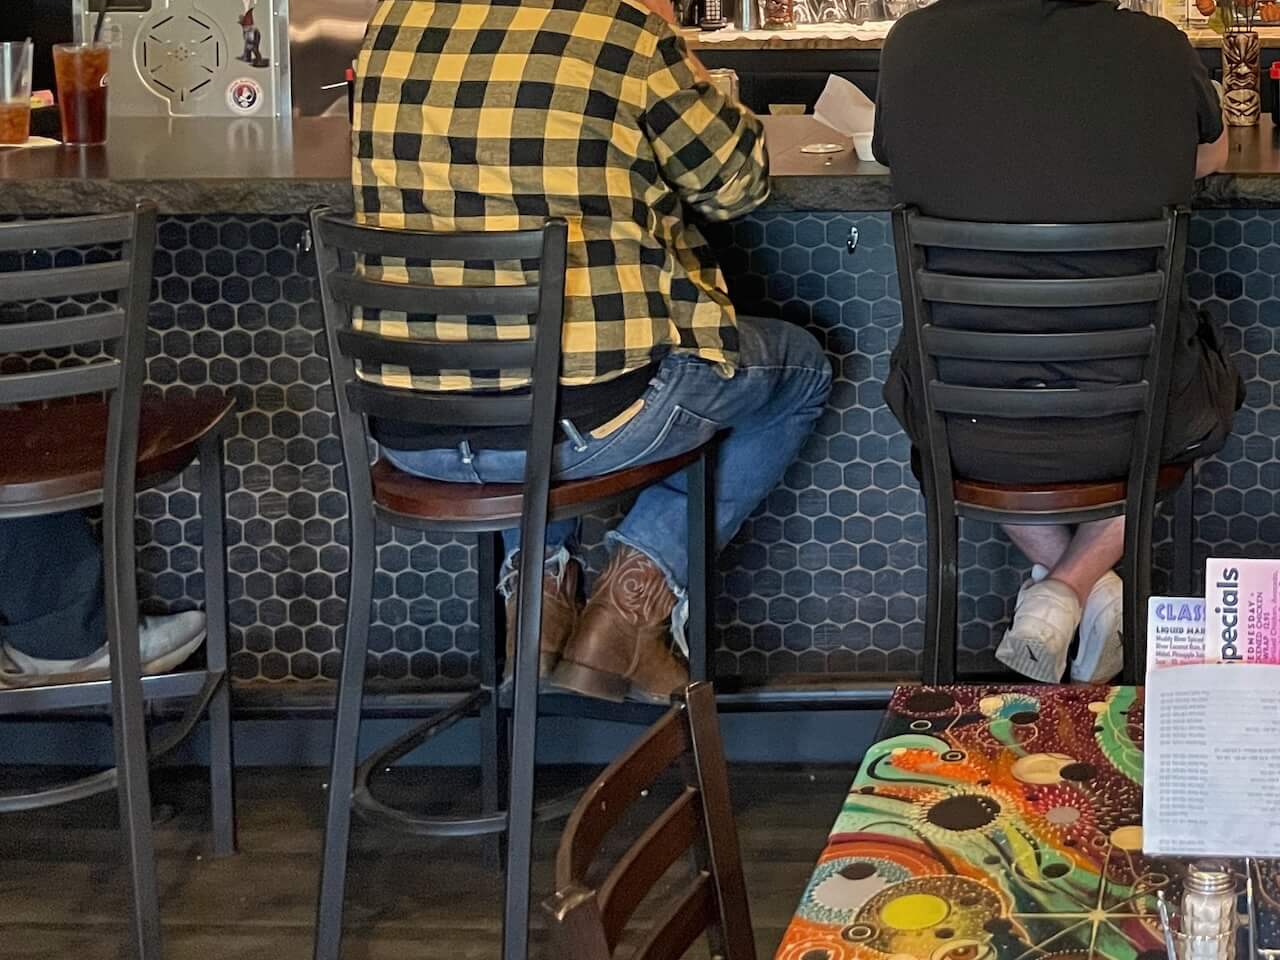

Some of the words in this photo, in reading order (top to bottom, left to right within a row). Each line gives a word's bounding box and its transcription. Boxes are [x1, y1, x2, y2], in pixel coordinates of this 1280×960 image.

[1155, 603, 1205, 621] CLAS
[1215, 568, 1242, 664] pecials
[1156, 625, 1184, 634] LIQUID
